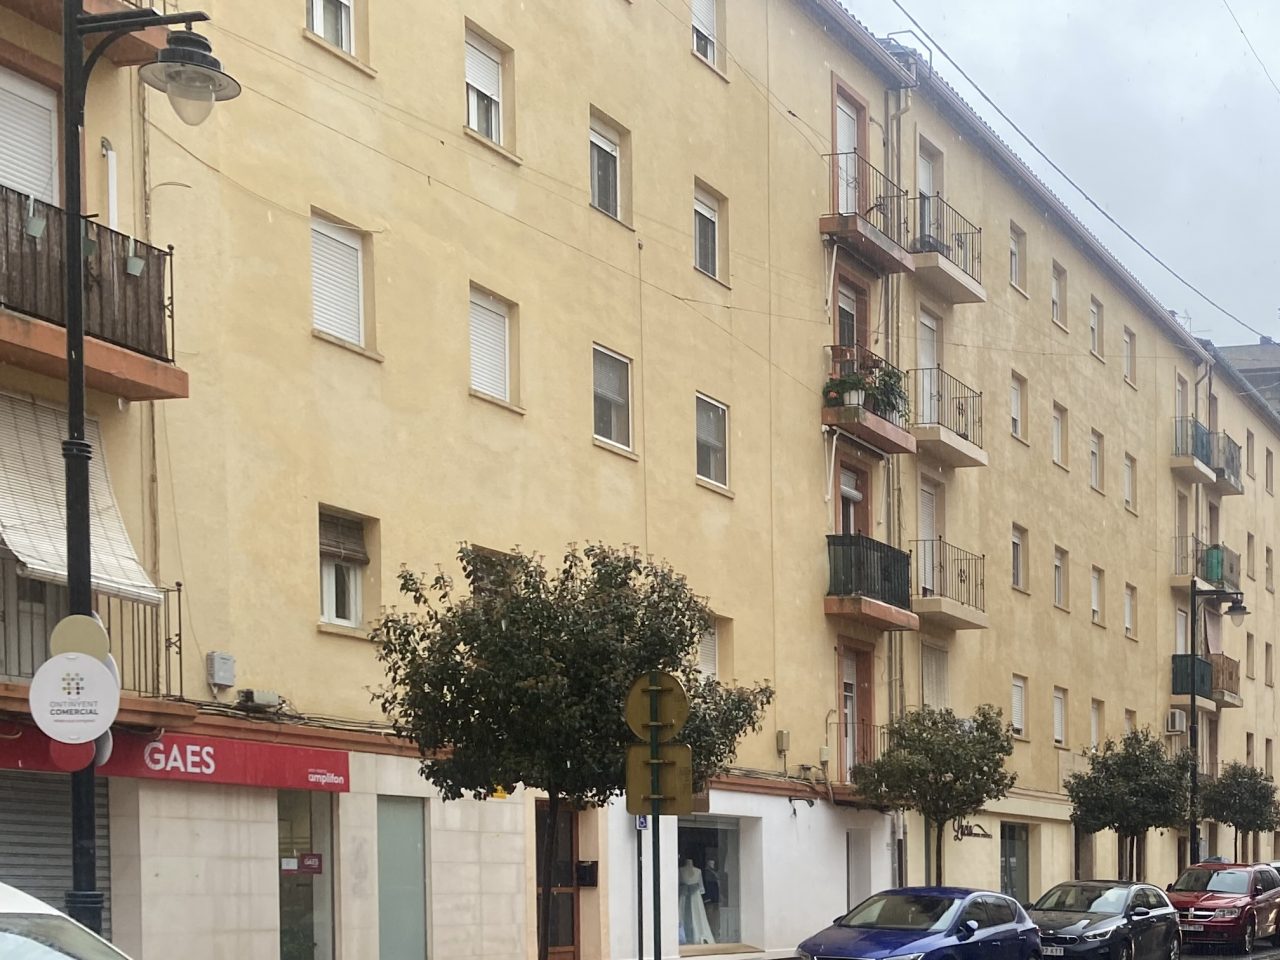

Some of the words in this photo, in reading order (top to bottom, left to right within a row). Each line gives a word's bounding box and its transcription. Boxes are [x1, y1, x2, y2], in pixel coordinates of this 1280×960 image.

[49, 708, 99, 716] COMERCIAL
[144, 741, 215, 775] GAES
[308, 772, 344, 785] amplifon
